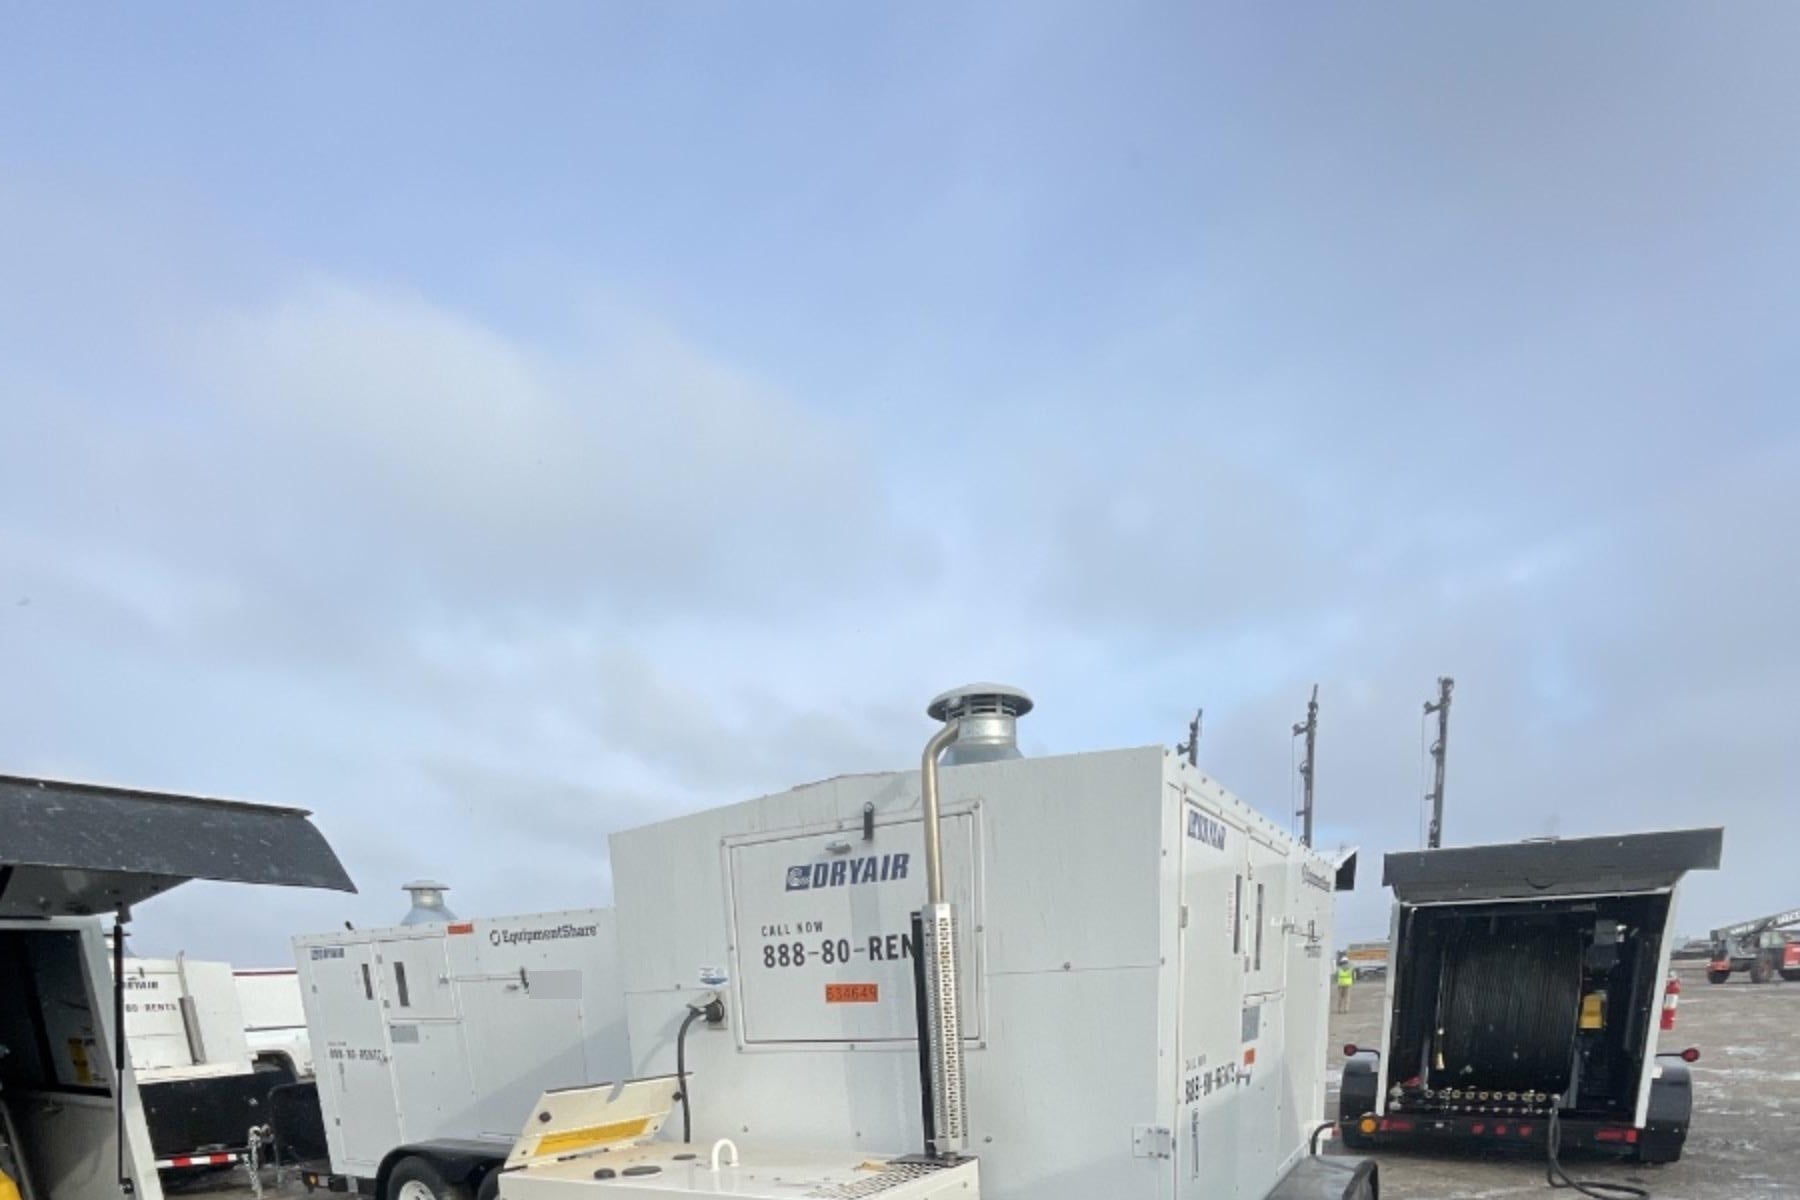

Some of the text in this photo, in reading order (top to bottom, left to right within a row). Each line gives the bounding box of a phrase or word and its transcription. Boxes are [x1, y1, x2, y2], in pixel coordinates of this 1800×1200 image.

[812, 852, 911, 889] DRYAIR
[502, 923, 598, 945] EquipmentShare
[761, 920, 824, 937] CALL NOW
[763, 934, 915, 968] 888-80-REN
